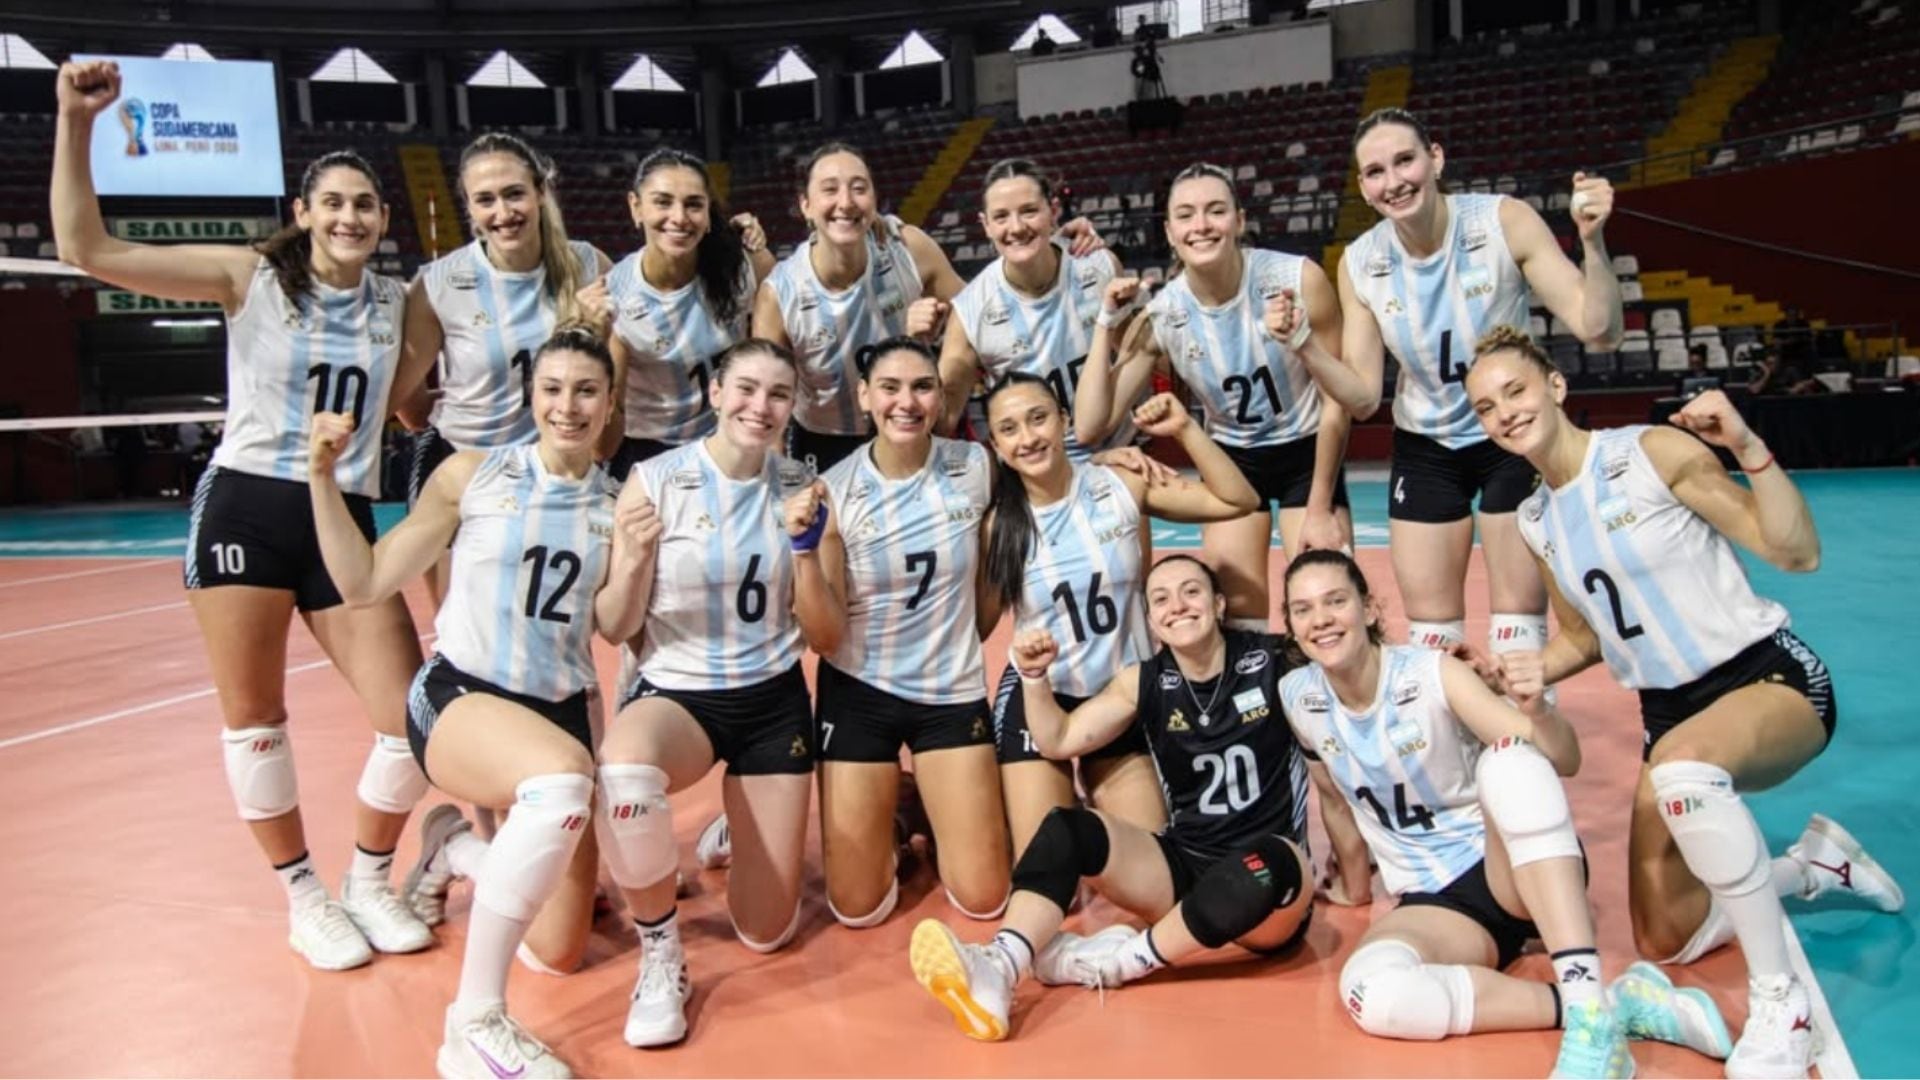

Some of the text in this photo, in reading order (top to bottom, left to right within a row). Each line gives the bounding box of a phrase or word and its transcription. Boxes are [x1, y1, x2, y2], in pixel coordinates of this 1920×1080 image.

[150, 102, 180, 119] COPA
[153, 121, 238, 138] SUDAMERICANA
[127, 221, 248, 237] SALIDA
[1439, 329, 1471, 384] 4
[307, 361, 369, 434] 10
[1222, 364, 1283, 425] 21
[1393, 475, 1406, 504] 4
[1605, 511, 1638, 534] ARG
[210, 542, 246, 575] 10
[522, 544, 582, 624] 12
[904, 550, 938, 611] 7
[736, 553, 768, 624] 6
[1051, 570, 1119, 644] 16
[1582, 567, 1645, 641] 2
[820, 720, 836, 752] 7
[1241, 706, 1270, 725] ARG
[1191, 743, 1262, 816] 20
[1354, 782, 1436, 832] 14
